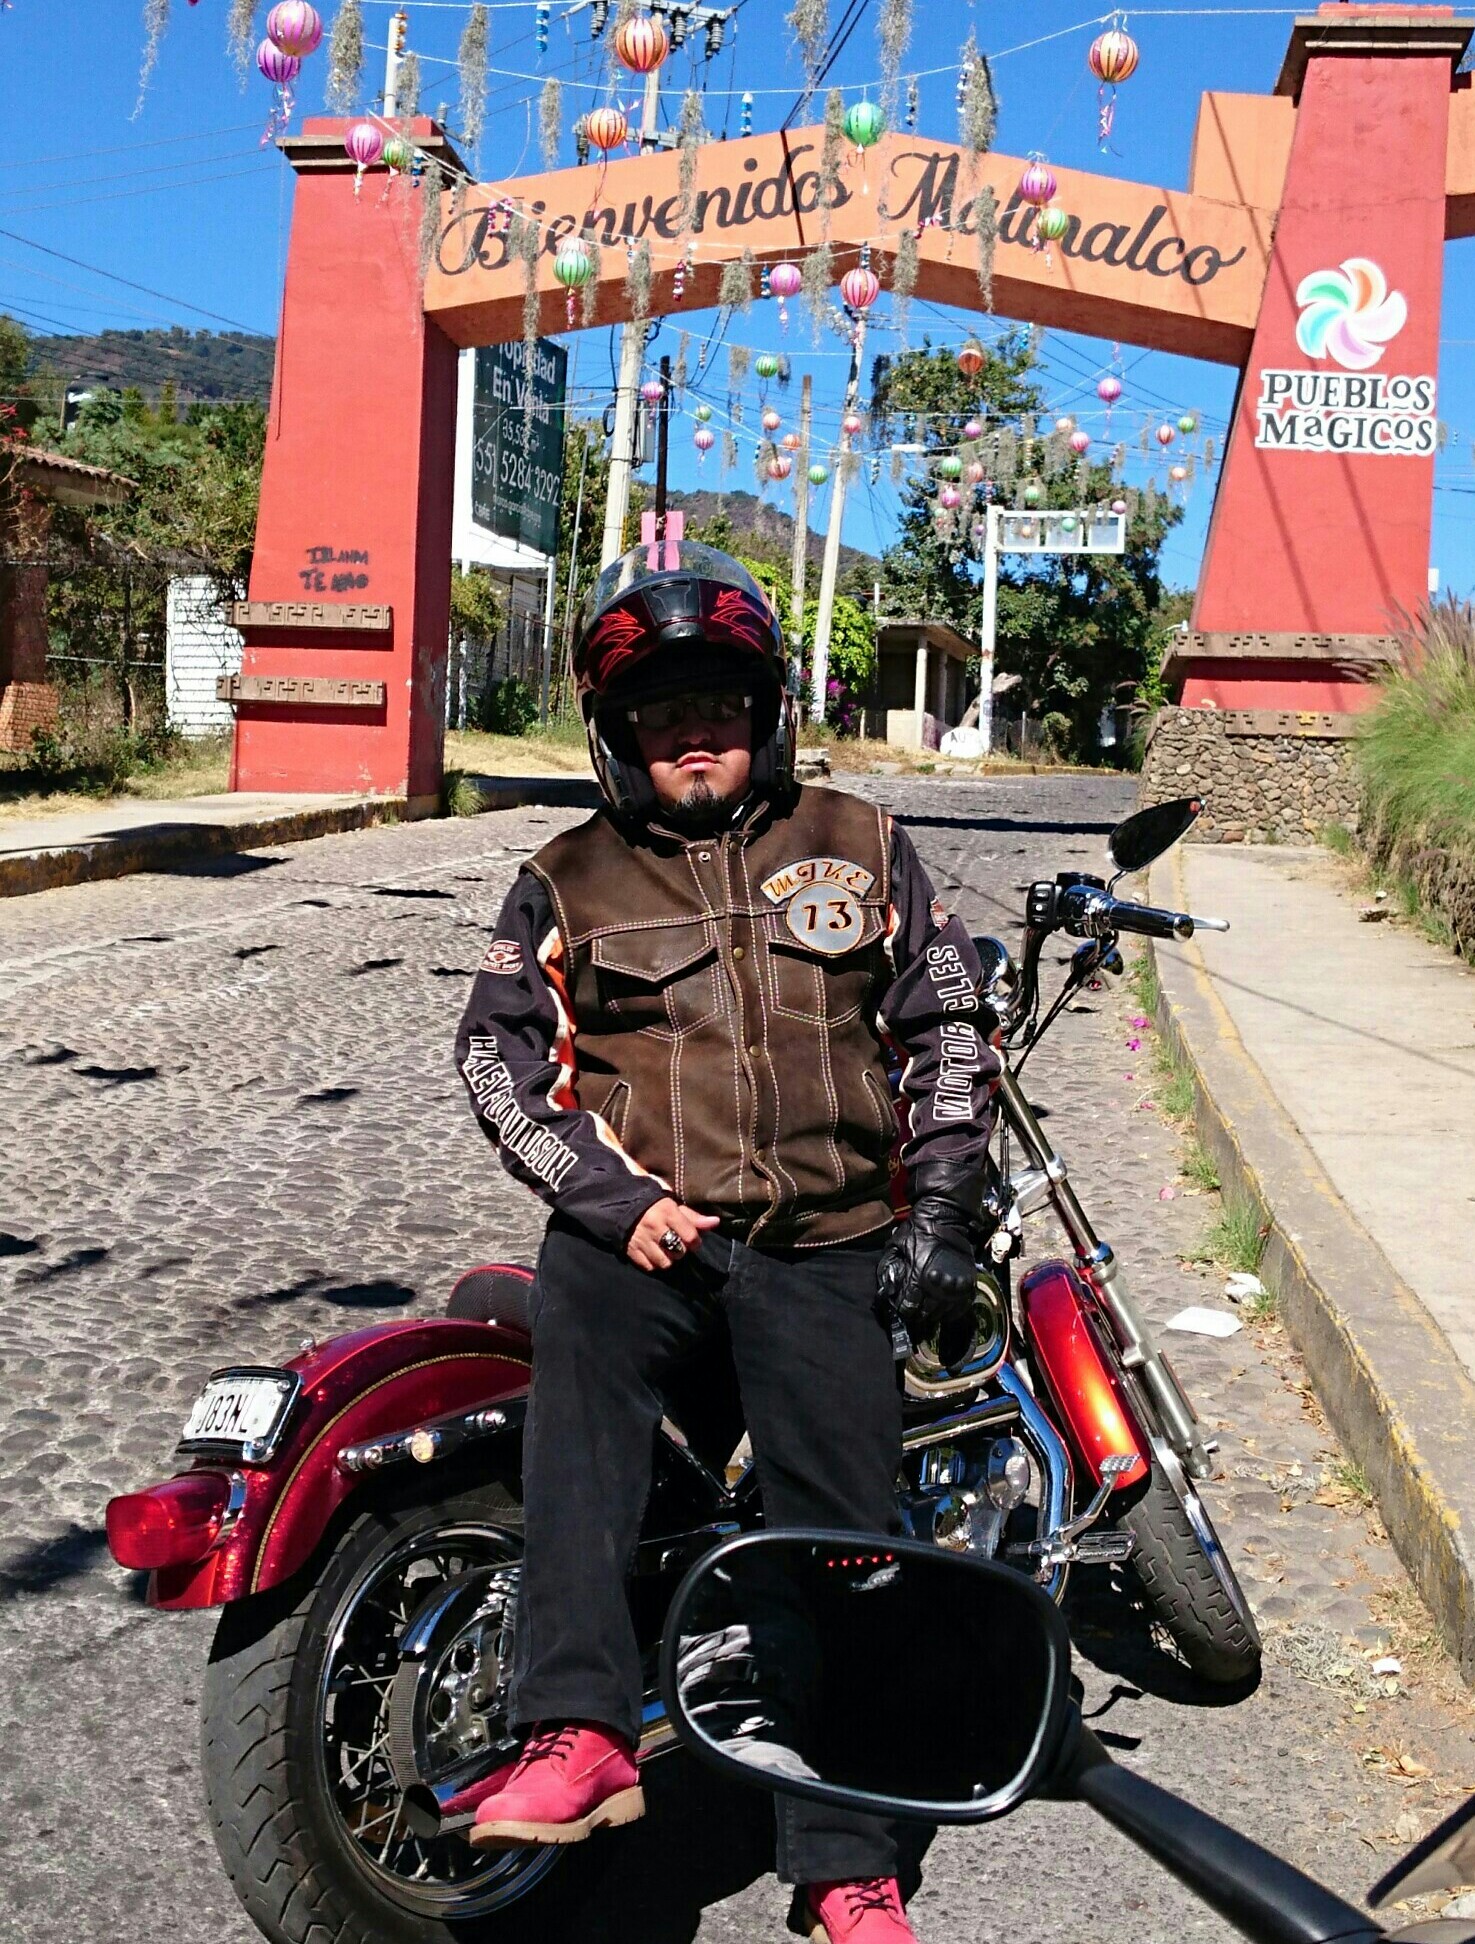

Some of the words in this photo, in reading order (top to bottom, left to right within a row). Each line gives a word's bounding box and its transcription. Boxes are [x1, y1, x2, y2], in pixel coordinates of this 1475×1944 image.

[435, 144, 853, 276] Bienvenidos
[492, 365, 512, 404] En
[500, 450, 532, 494] 5284
[533, 465, 560, 507] 3292
[299, 567, 327, 592] TE
[763, 861, 868, 897] MIKE
[803, 901, 852, 931] 13
[932, 1021, 981, 1121] MOTOR
